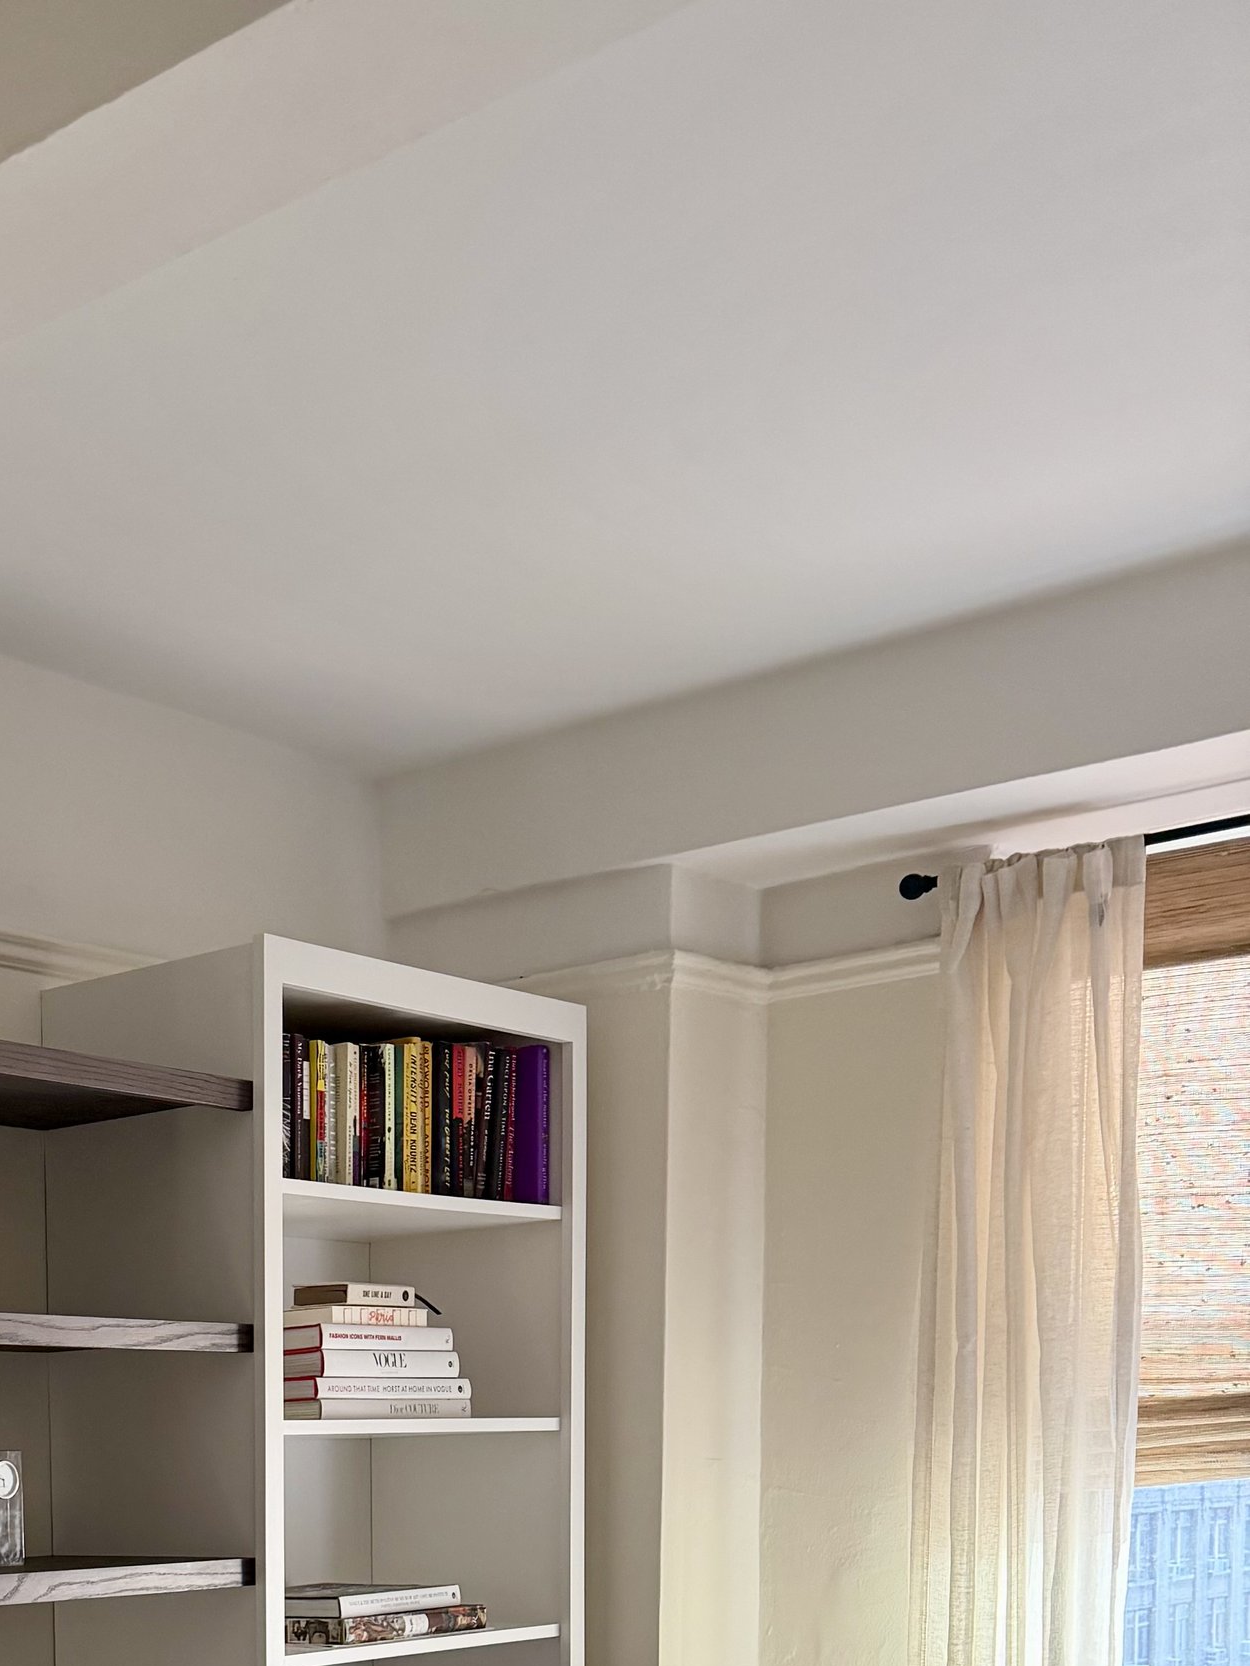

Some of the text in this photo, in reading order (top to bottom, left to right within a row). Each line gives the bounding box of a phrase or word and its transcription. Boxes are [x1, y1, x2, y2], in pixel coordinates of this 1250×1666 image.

[410, 1054, 418, 1106] INTENSITY
[484, 1051, 496, 1120] Ina Garten
[369, 1310, 394, 1322] Paris
[329, 1332, 349, 1340] FASHION
[372, 1352, 407, 1369] VOGUE
[327, 1384, 452, 1393] AROUND THAT TIME HORST AT HOME IN VOGUE
[403, 1404, 440, 1414] COUTURE
